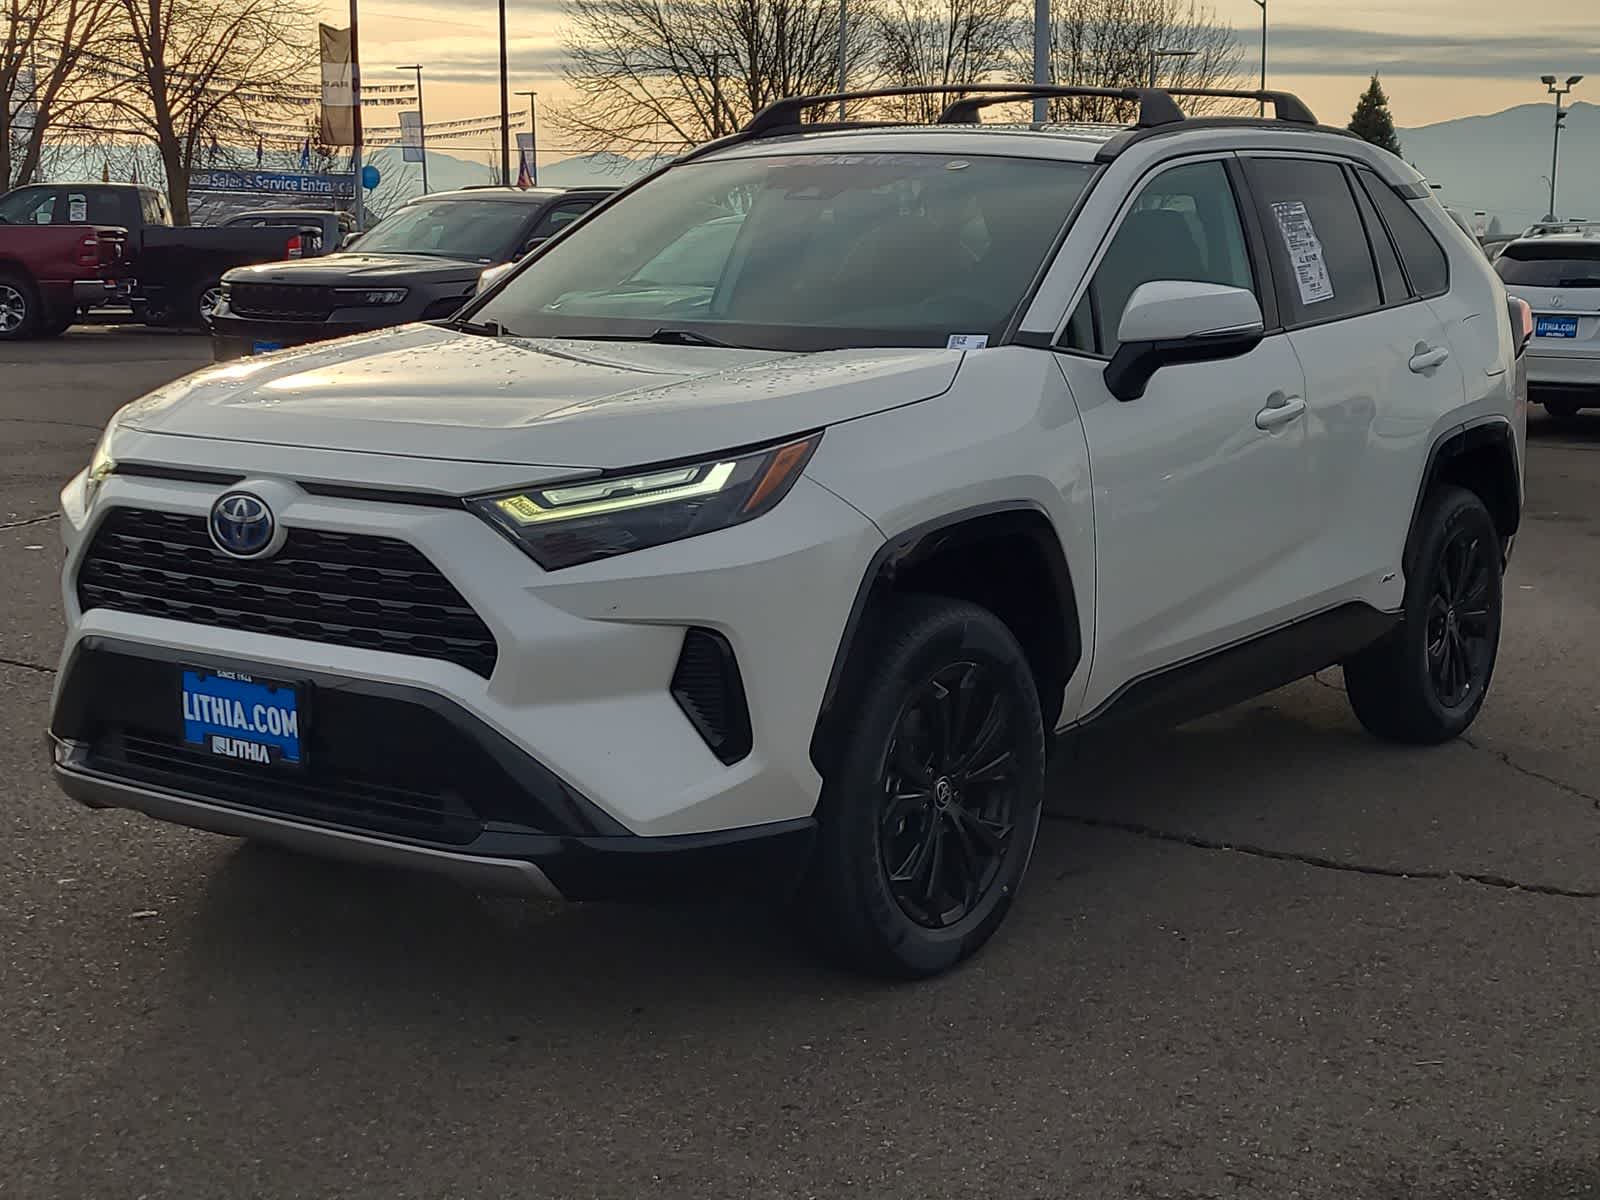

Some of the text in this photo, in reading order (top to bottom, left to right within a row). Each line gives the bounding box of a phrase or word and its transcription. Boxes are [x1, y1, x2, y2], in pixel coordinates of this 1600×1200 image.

[256, 176, 298, 191] Service
[1537, 321, 1576, 332] LITHIA.COM
[183, 691, 299, 739] LITHIA.COM
[225, 737, 270, 764] LITHIA
